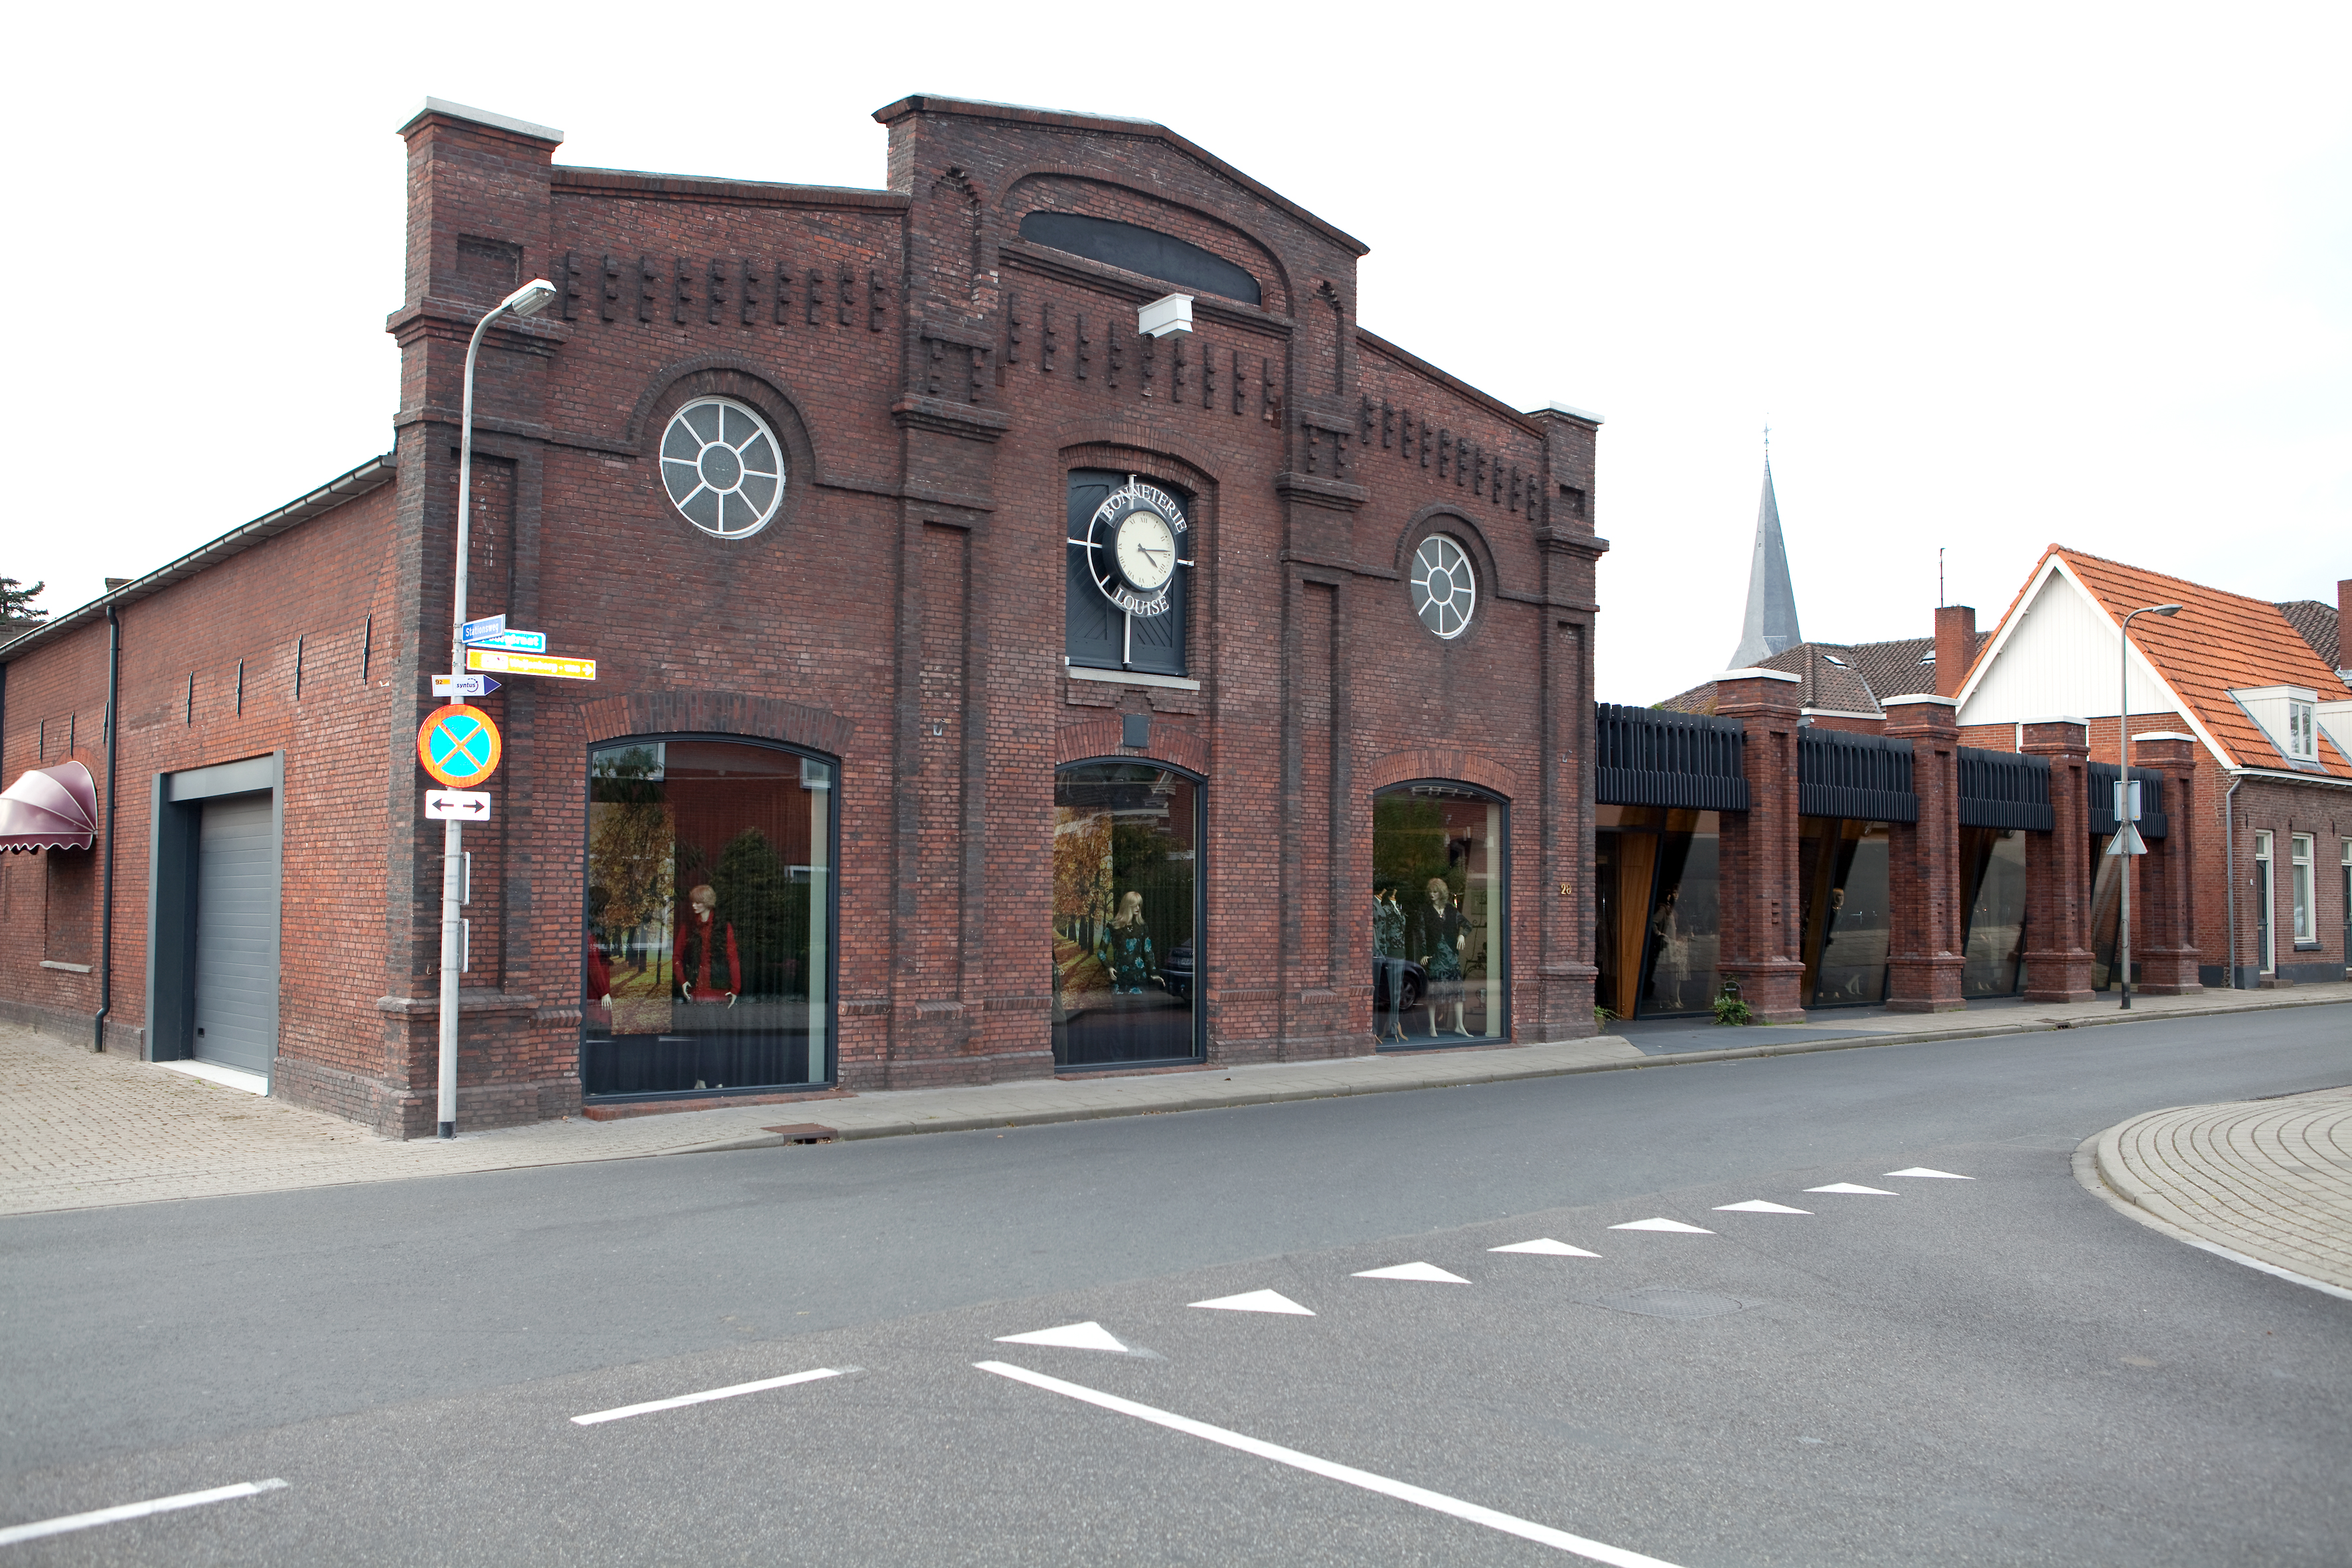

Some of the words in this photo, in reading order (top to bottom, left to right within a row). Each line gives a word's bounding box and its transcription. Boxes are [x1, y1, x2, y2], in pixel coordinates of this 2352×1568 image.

[1101, 484, 1188, 532] BONNETERIE
[1113, 588, 1169, 616] LOUISE
[465, 623, 499, 637] Stationsweg
[1561, 884, 1572, 895] 28
